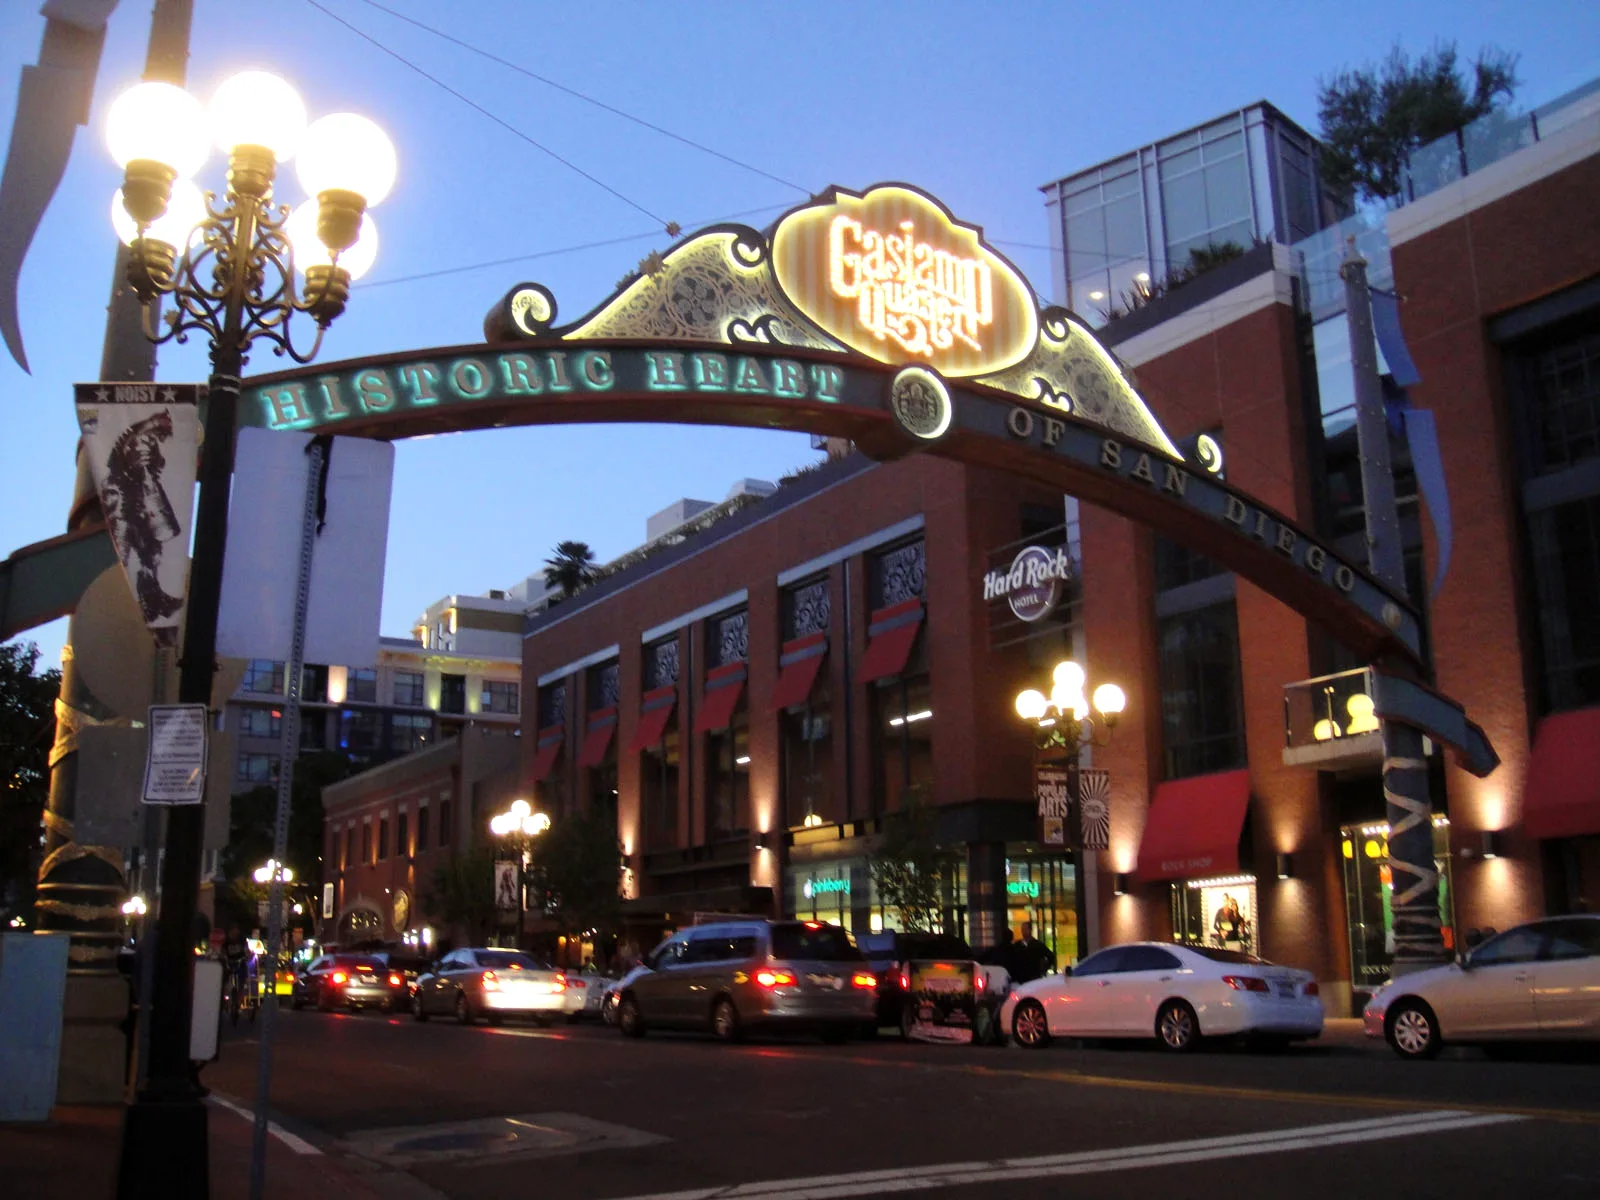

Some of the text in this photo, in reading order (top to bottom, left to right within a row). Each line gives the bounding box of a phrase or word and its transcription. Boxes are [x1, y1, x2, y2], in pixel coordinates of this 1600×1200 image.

[115, 384, 157, 403] NOISY
[260, 350, 1356, 593] HISTORIC HEART OF SAN DIEGO
[983, 548, 1068, 600] Hard Rock
[1013, 593, 1040, 609] HOTEL
[1038, 795, 1068, 818] ARTS
